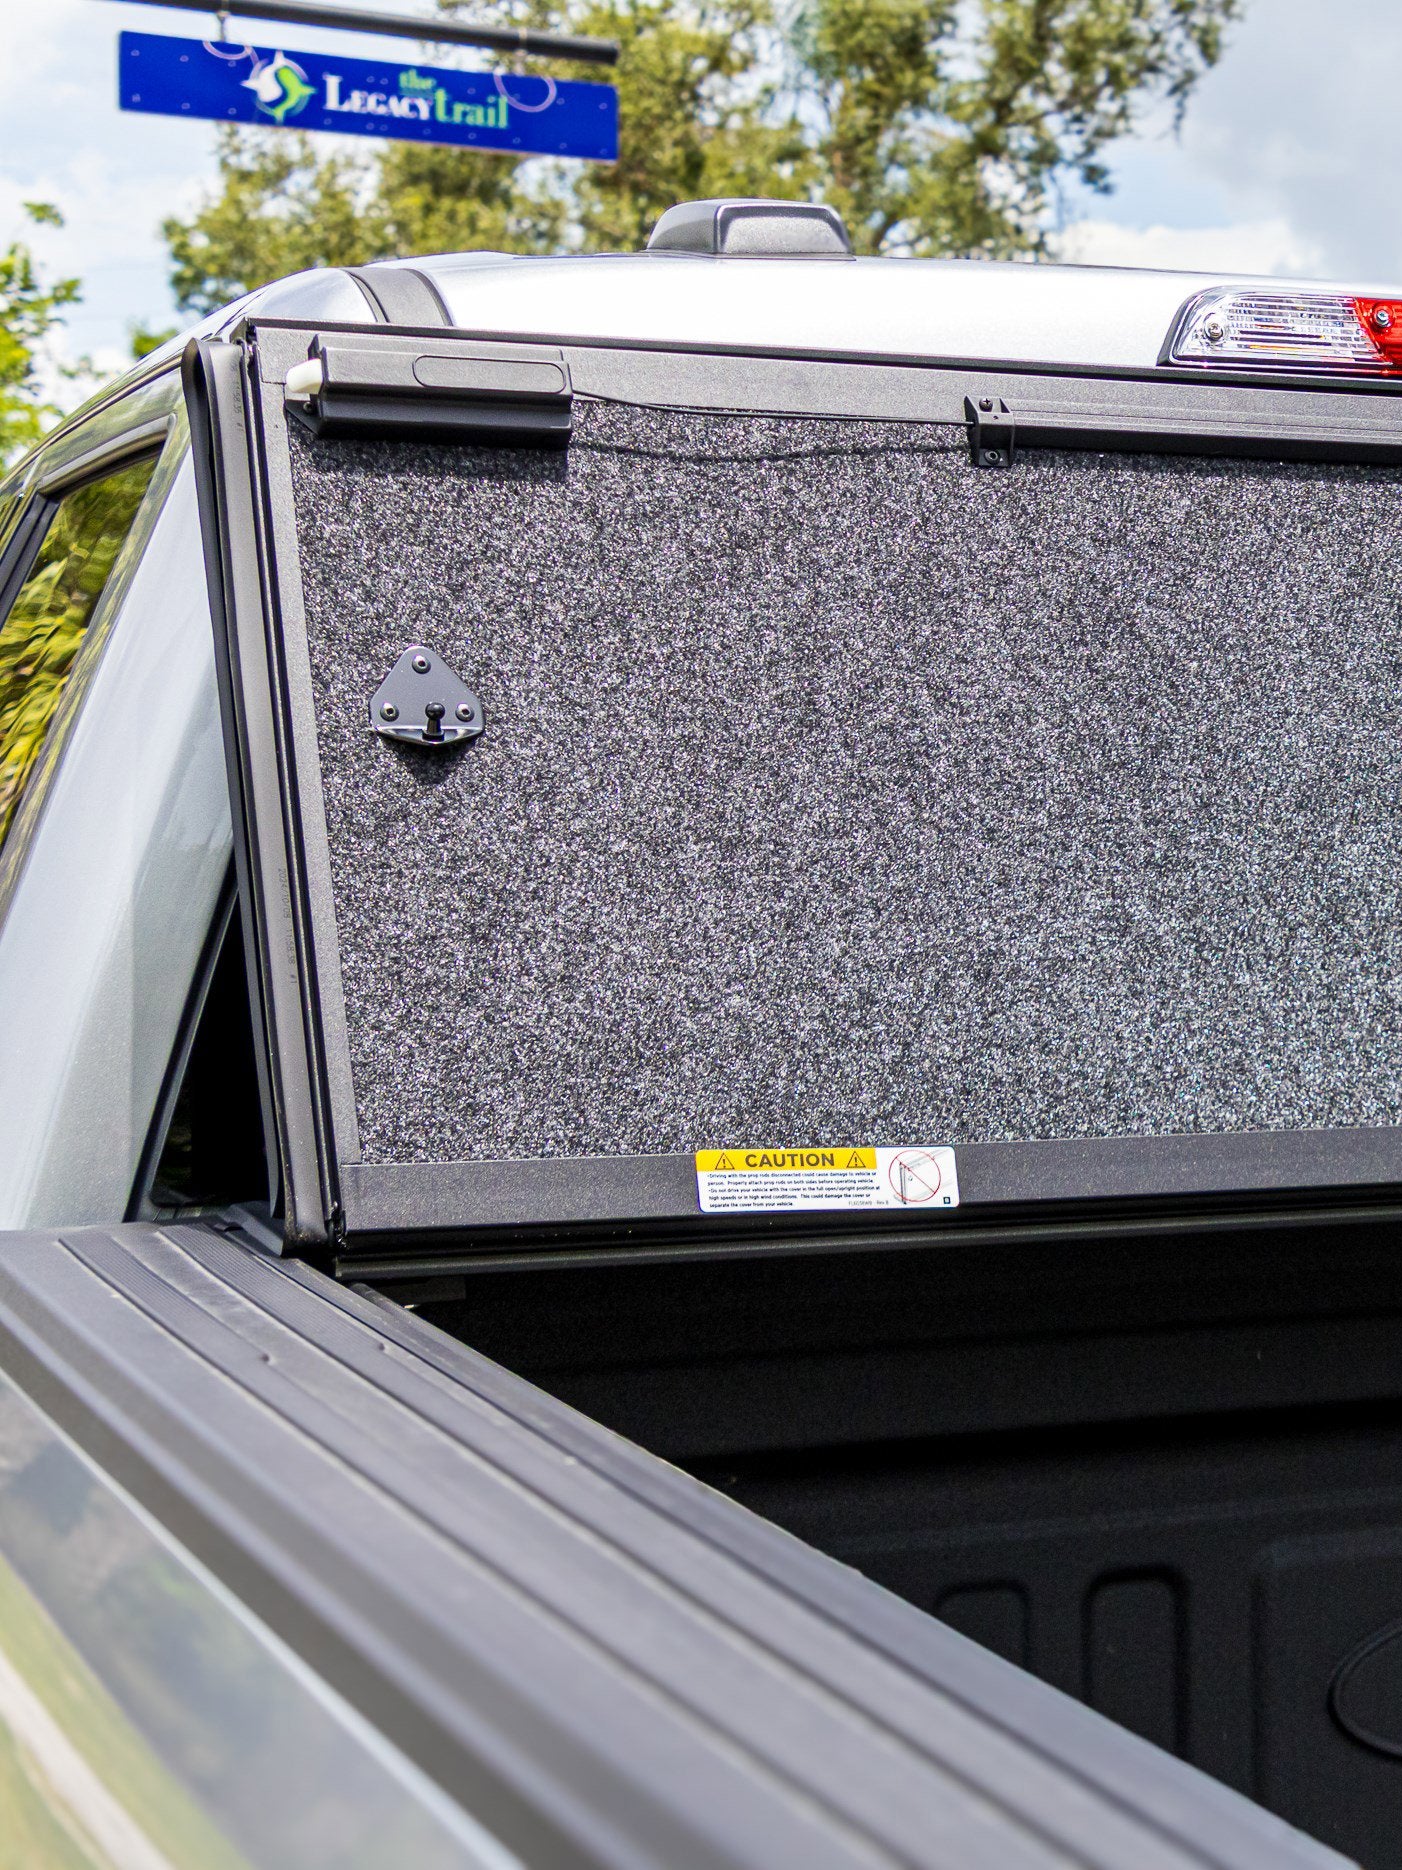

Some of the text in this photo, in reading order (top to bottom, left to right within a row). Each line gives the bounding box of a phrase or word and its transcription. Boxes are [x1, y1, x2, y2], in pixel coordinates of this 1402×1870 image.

[399, 68, 435, 90] the
[434, 88, 508, 128] trail
[745, 1153, 835, 1167] CAUTION
